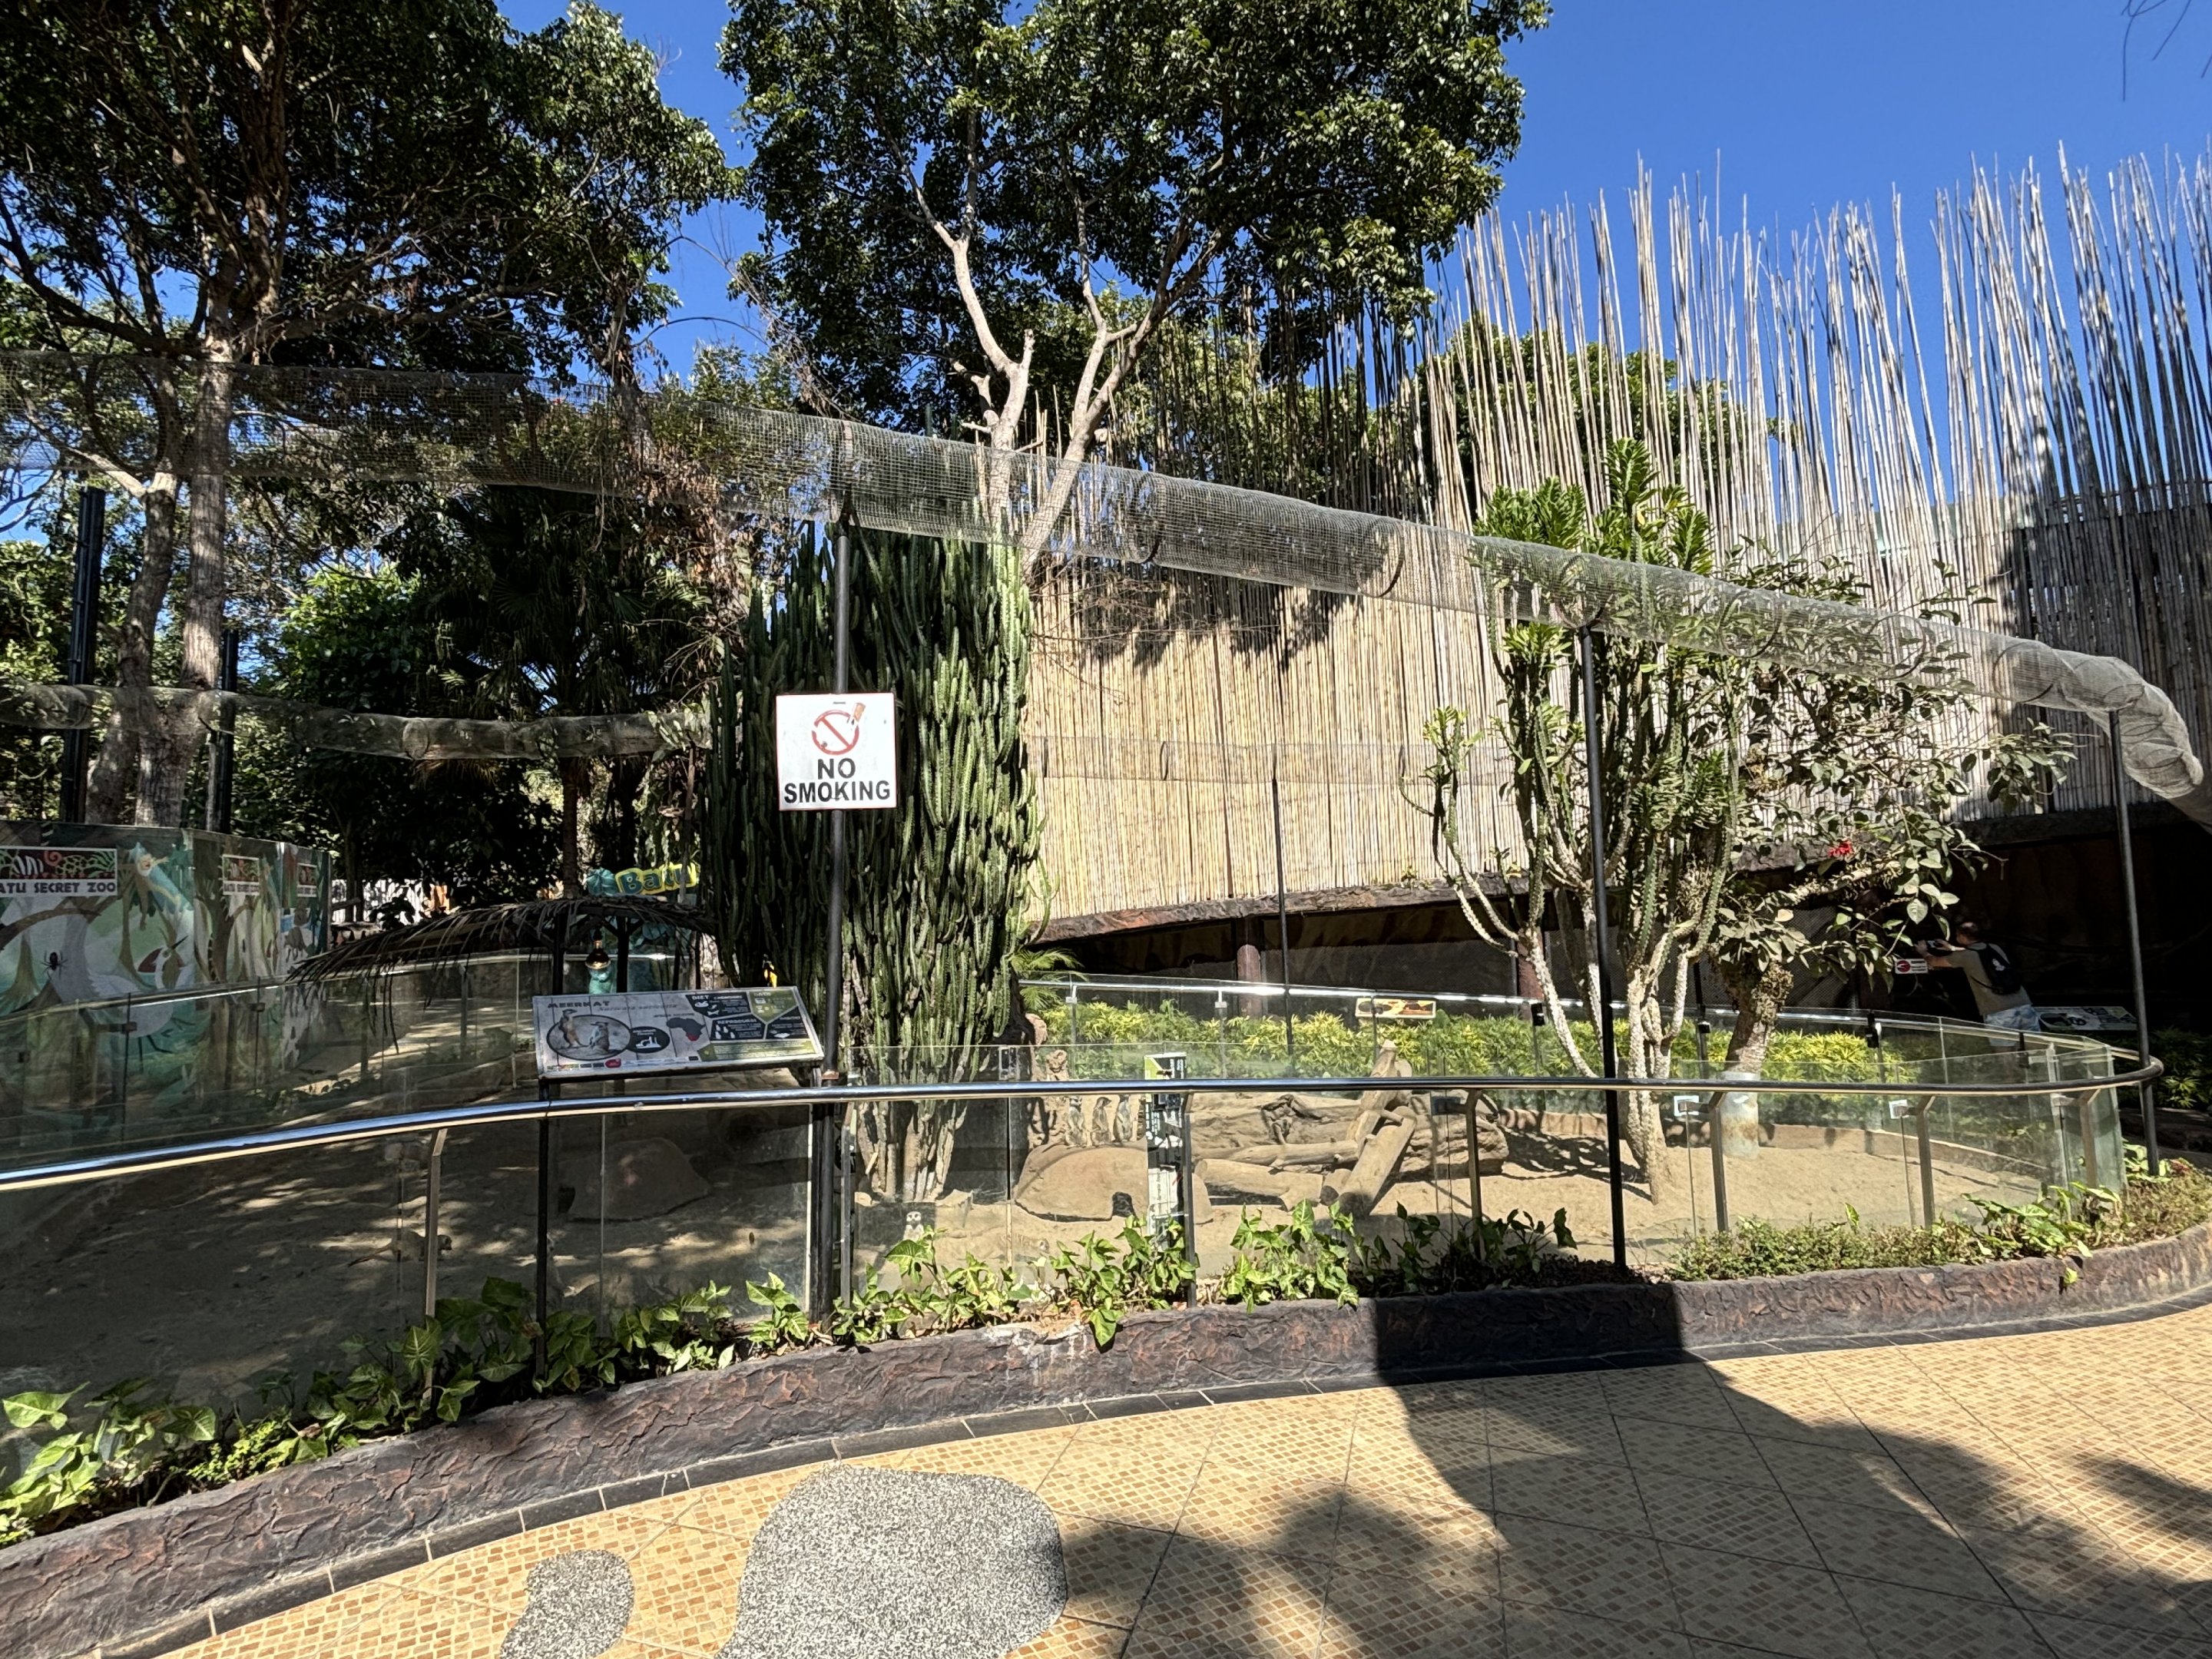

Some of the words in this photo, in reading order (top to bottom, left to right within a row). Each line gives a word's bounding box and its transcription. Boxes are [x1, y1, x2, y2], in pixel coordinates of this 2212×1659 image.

[817, 757, 856, 780] NO
[783, 780, 891, 804] SMOKING
[35, 882, 81, 893] SECRET
[87, 882, 116, 892] ZOO
[547, 1000, 611, 1008] MEERKAT
